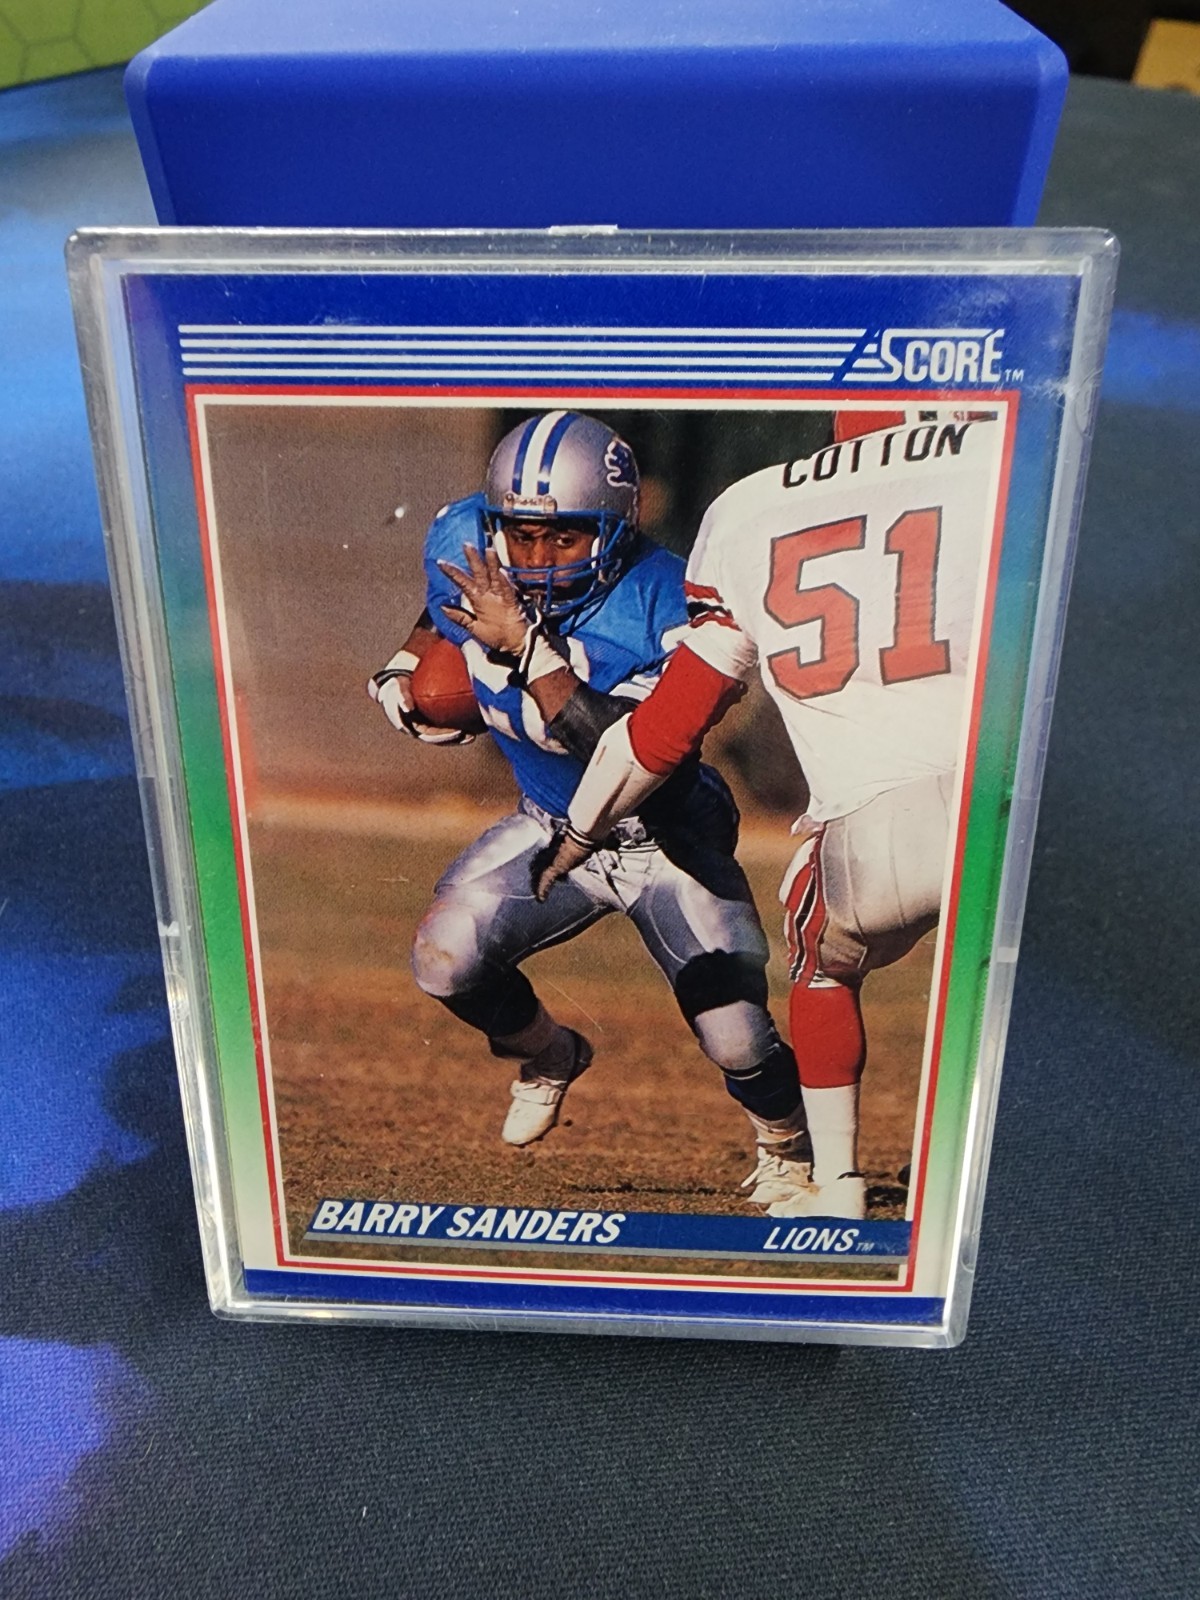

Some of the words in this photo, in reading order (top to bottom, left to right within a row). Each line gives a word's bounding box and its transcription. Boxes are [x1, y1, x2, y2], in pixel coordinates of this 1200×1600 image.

[843, 328, 1005, 382] SCORE
[782, 423, 972, 489] COTTON
[763, 505, 951, 700] 51
[312, 1200, 446, 1235] BARRY
[446, 1206, 626, 1244] SANDERS
[763, 1226, 860, 1252] LIONS
